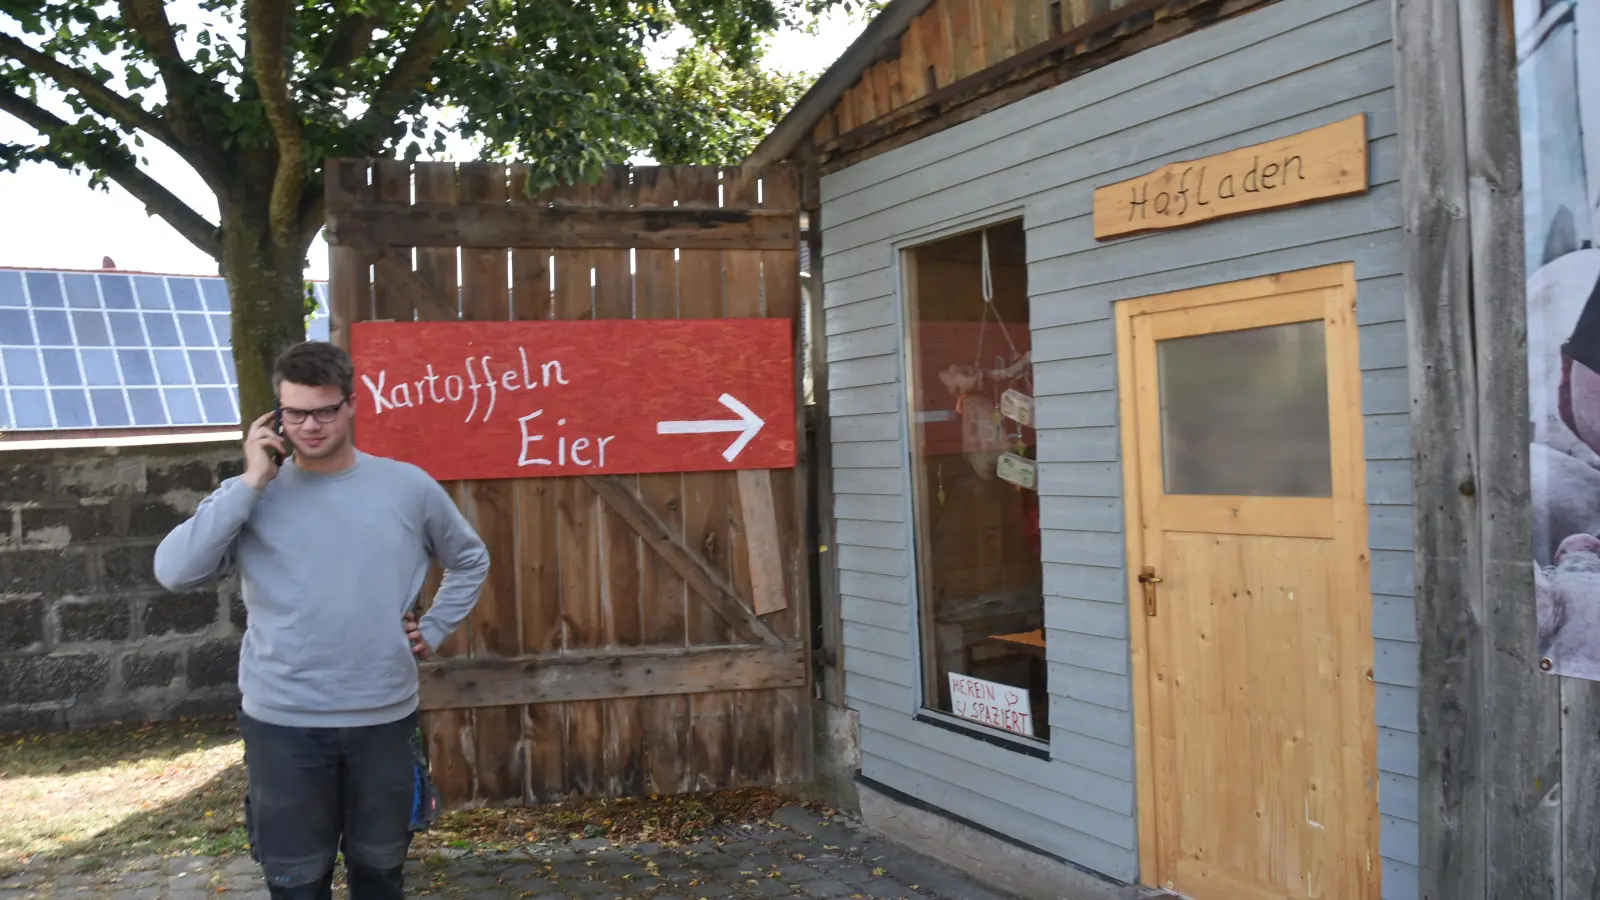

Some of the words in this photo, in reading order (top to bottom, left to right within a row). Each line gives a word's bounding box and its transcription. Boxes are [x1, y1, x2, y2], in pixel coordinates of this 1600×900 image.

[361, 346, 570, 424] Kartoffeln
[517, 410, 616, 468] Eier
[952, 679, 996, 701] HEREIN
[970, 702, 1029, 733] SPAZIERT
